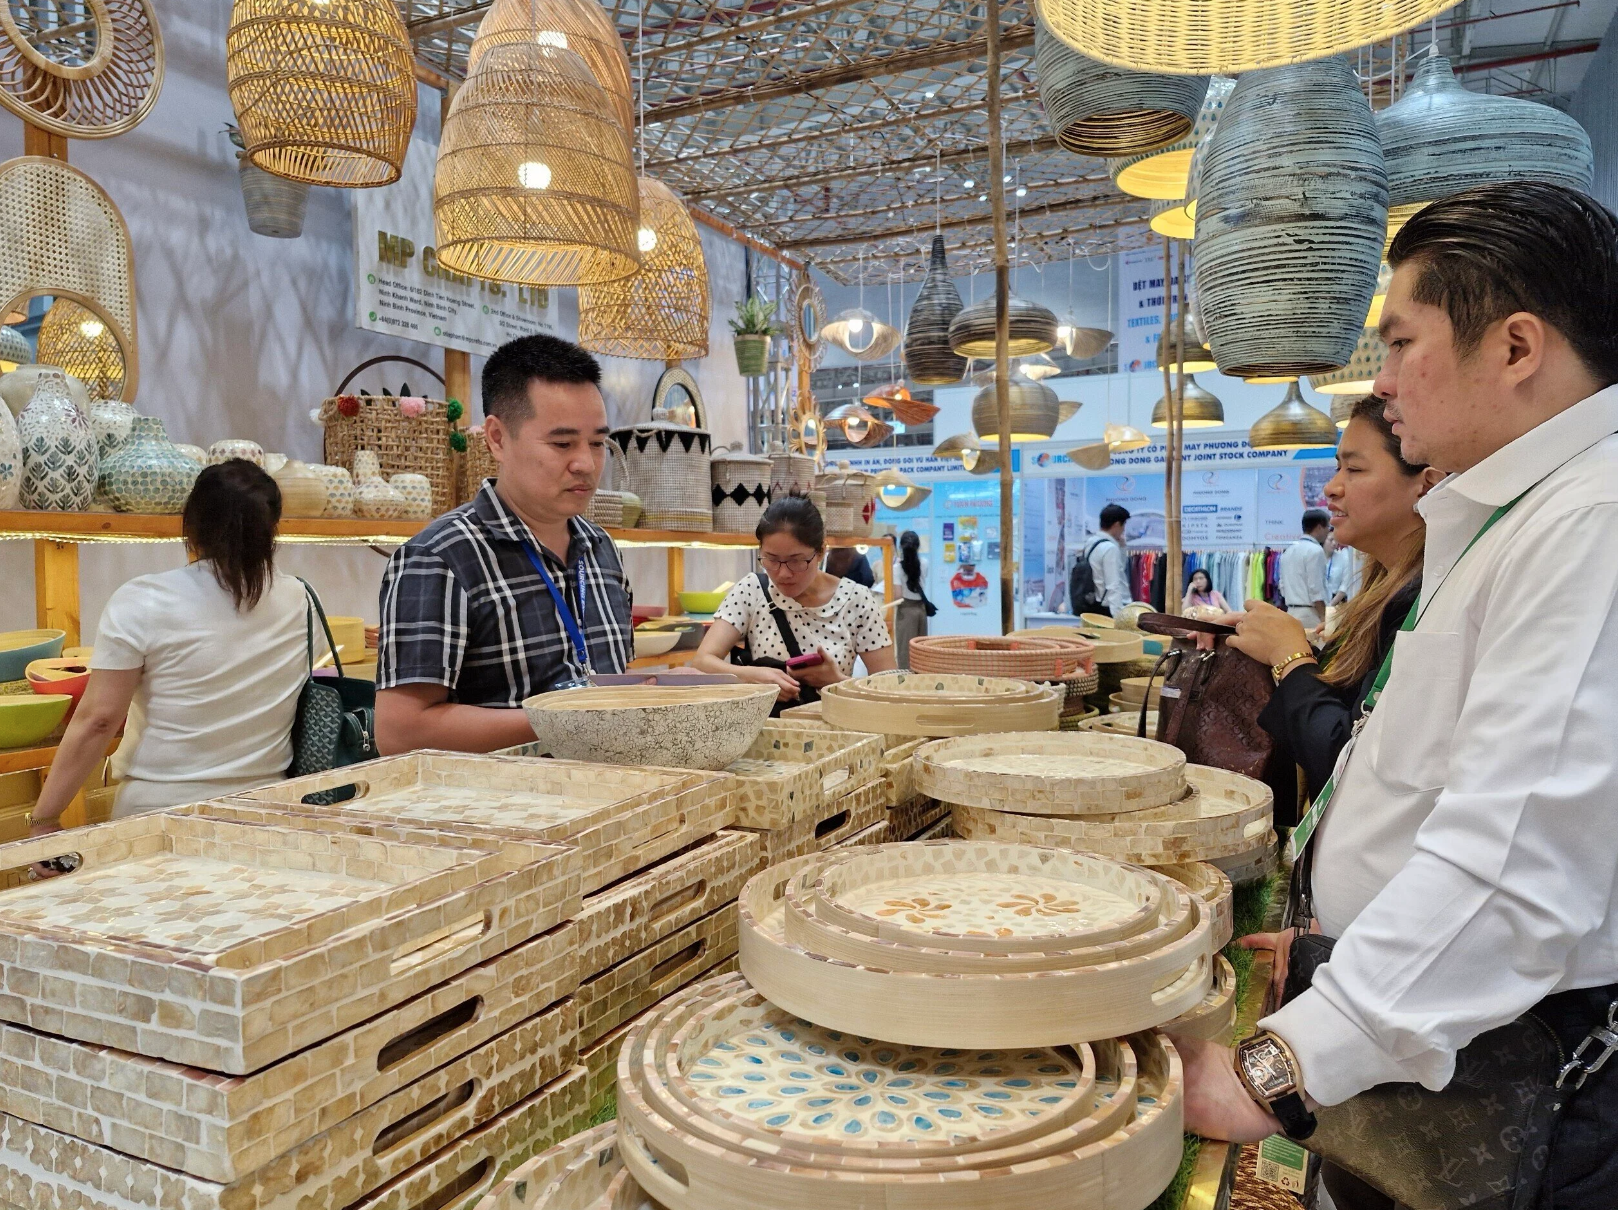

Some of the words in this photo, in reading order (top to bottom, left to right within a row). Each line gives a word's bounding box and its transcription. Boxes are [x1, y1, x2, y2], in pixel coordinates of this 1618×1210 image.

[378, 229, 415, 269] MP
[379, 278, 391, 287] Head
[379, 299, 391, 308] Ninh
[428, 311, 447, 322] Vietnam
[1184, 443, 1200, 451] MAY
[1129, 456, 1152, 464] DONG
[1193, 453, 1216, 461] JOINT
[1219, 451, 1244, 460] STOCK
[1247, 450, 1288, 458] COMPANY
